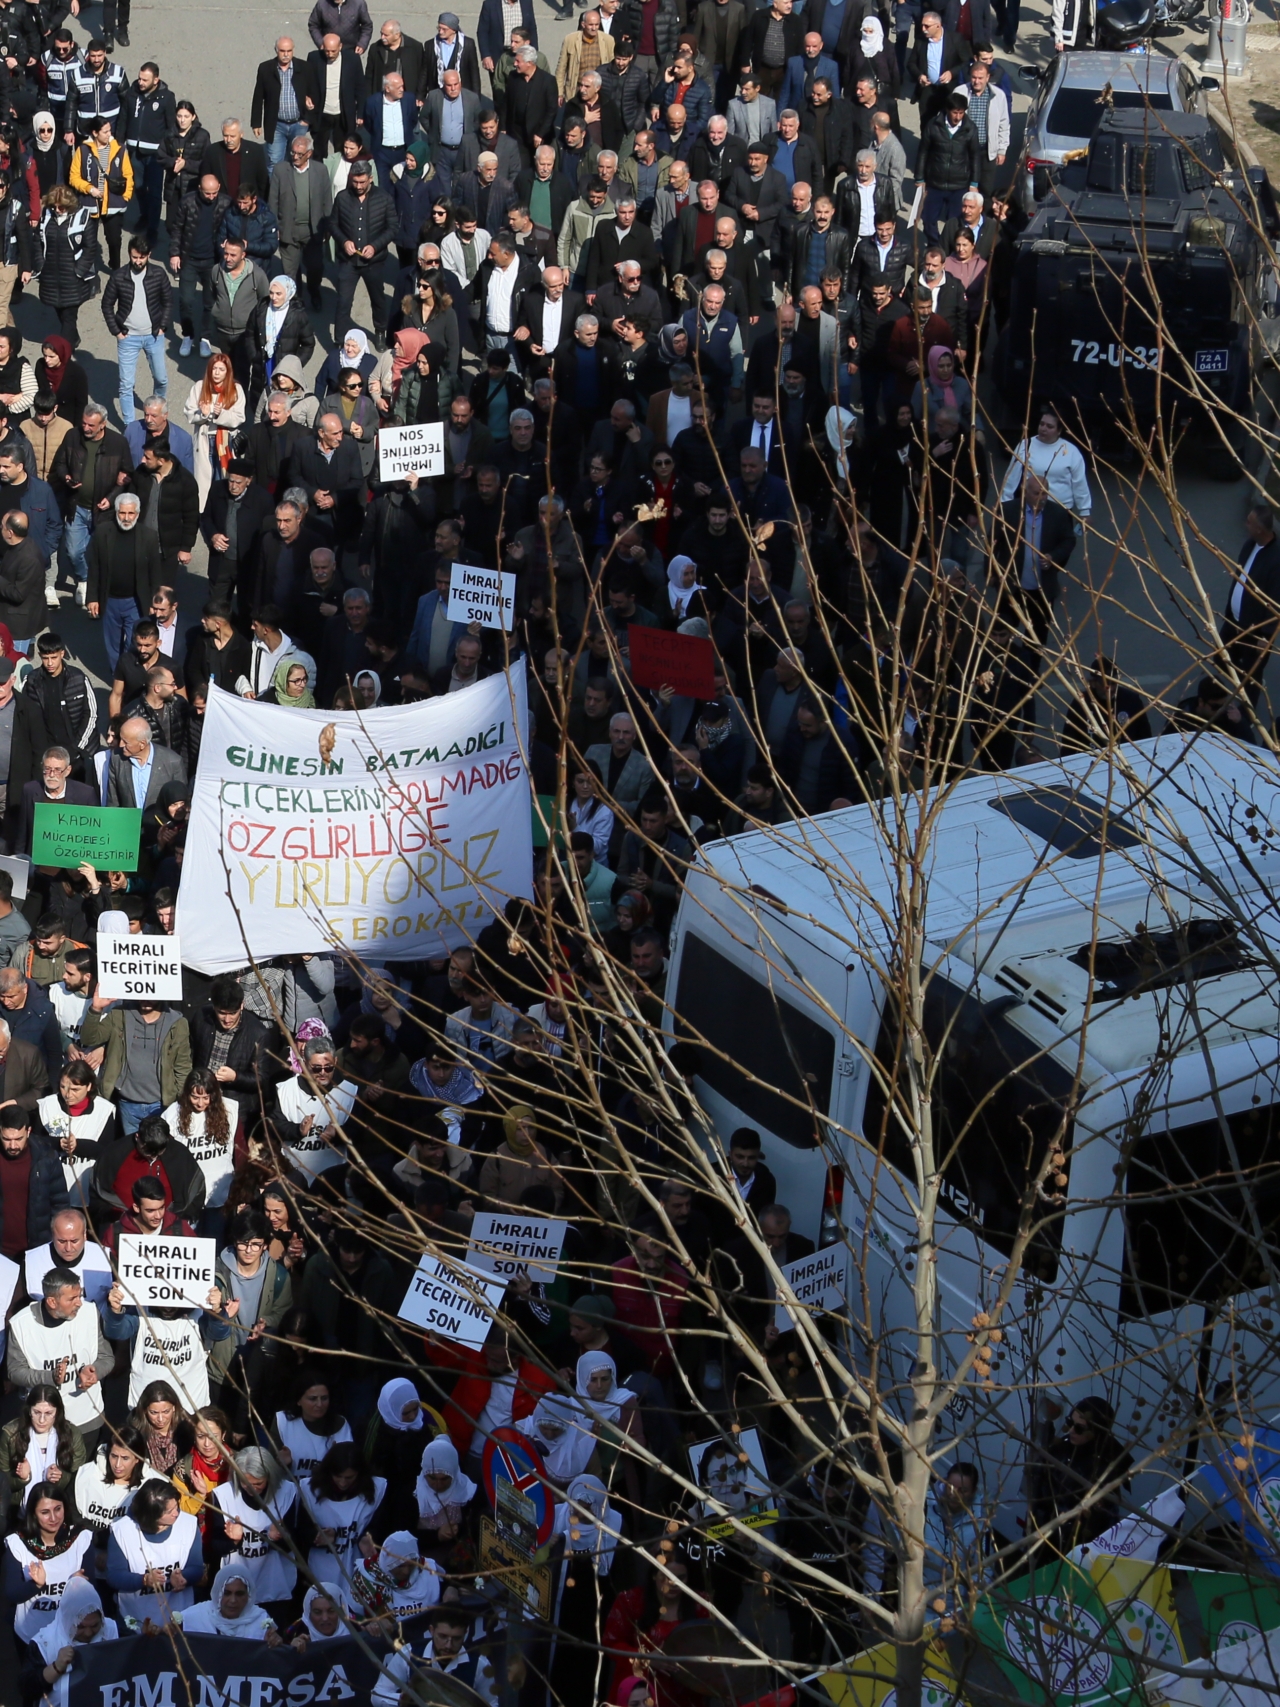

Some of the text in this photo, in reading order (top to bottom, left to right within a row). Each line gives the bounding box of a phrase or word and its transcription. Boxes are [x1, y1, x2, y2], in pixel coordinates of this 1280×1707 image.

[400, 429, 424, 441] SON
[382, 442, 442, 459] TECRİTİNE
[392, 459, 432, 474] İMRALI
[462, 570, 503, 591] İMRALI
[452, 588, 512, 609] TECRİTİNE
[467, 608, 492, 622] SON
[365, 721, 505, 773] BATMADIĞI
[388, 752, 523, 810] SOLMADIĞ
[58, 813, 102, 828] KADIN
[227, 803, 453, 860] ÖZGÜRLÜĞE
[239, 829, 503, 909] YÜRÜYORUZ
[113, 940, 164, 956] İMRALI
[101, 960, 178, 976] TECRİTİNE
[124, 982, 156, 994] SON
[490, 1220, 548, 1240] İMRALI
[138, 1242, 197, 1260] İMRALI
[122, 1263, 211, 1282] TECRİTİNE
[493, 1260, 528, 1274] SON
[790, 1254, 834, 1284] İMRALI
[148, 1286, 184, 1300] SON
[426, 1308, 461, 1334] SON
